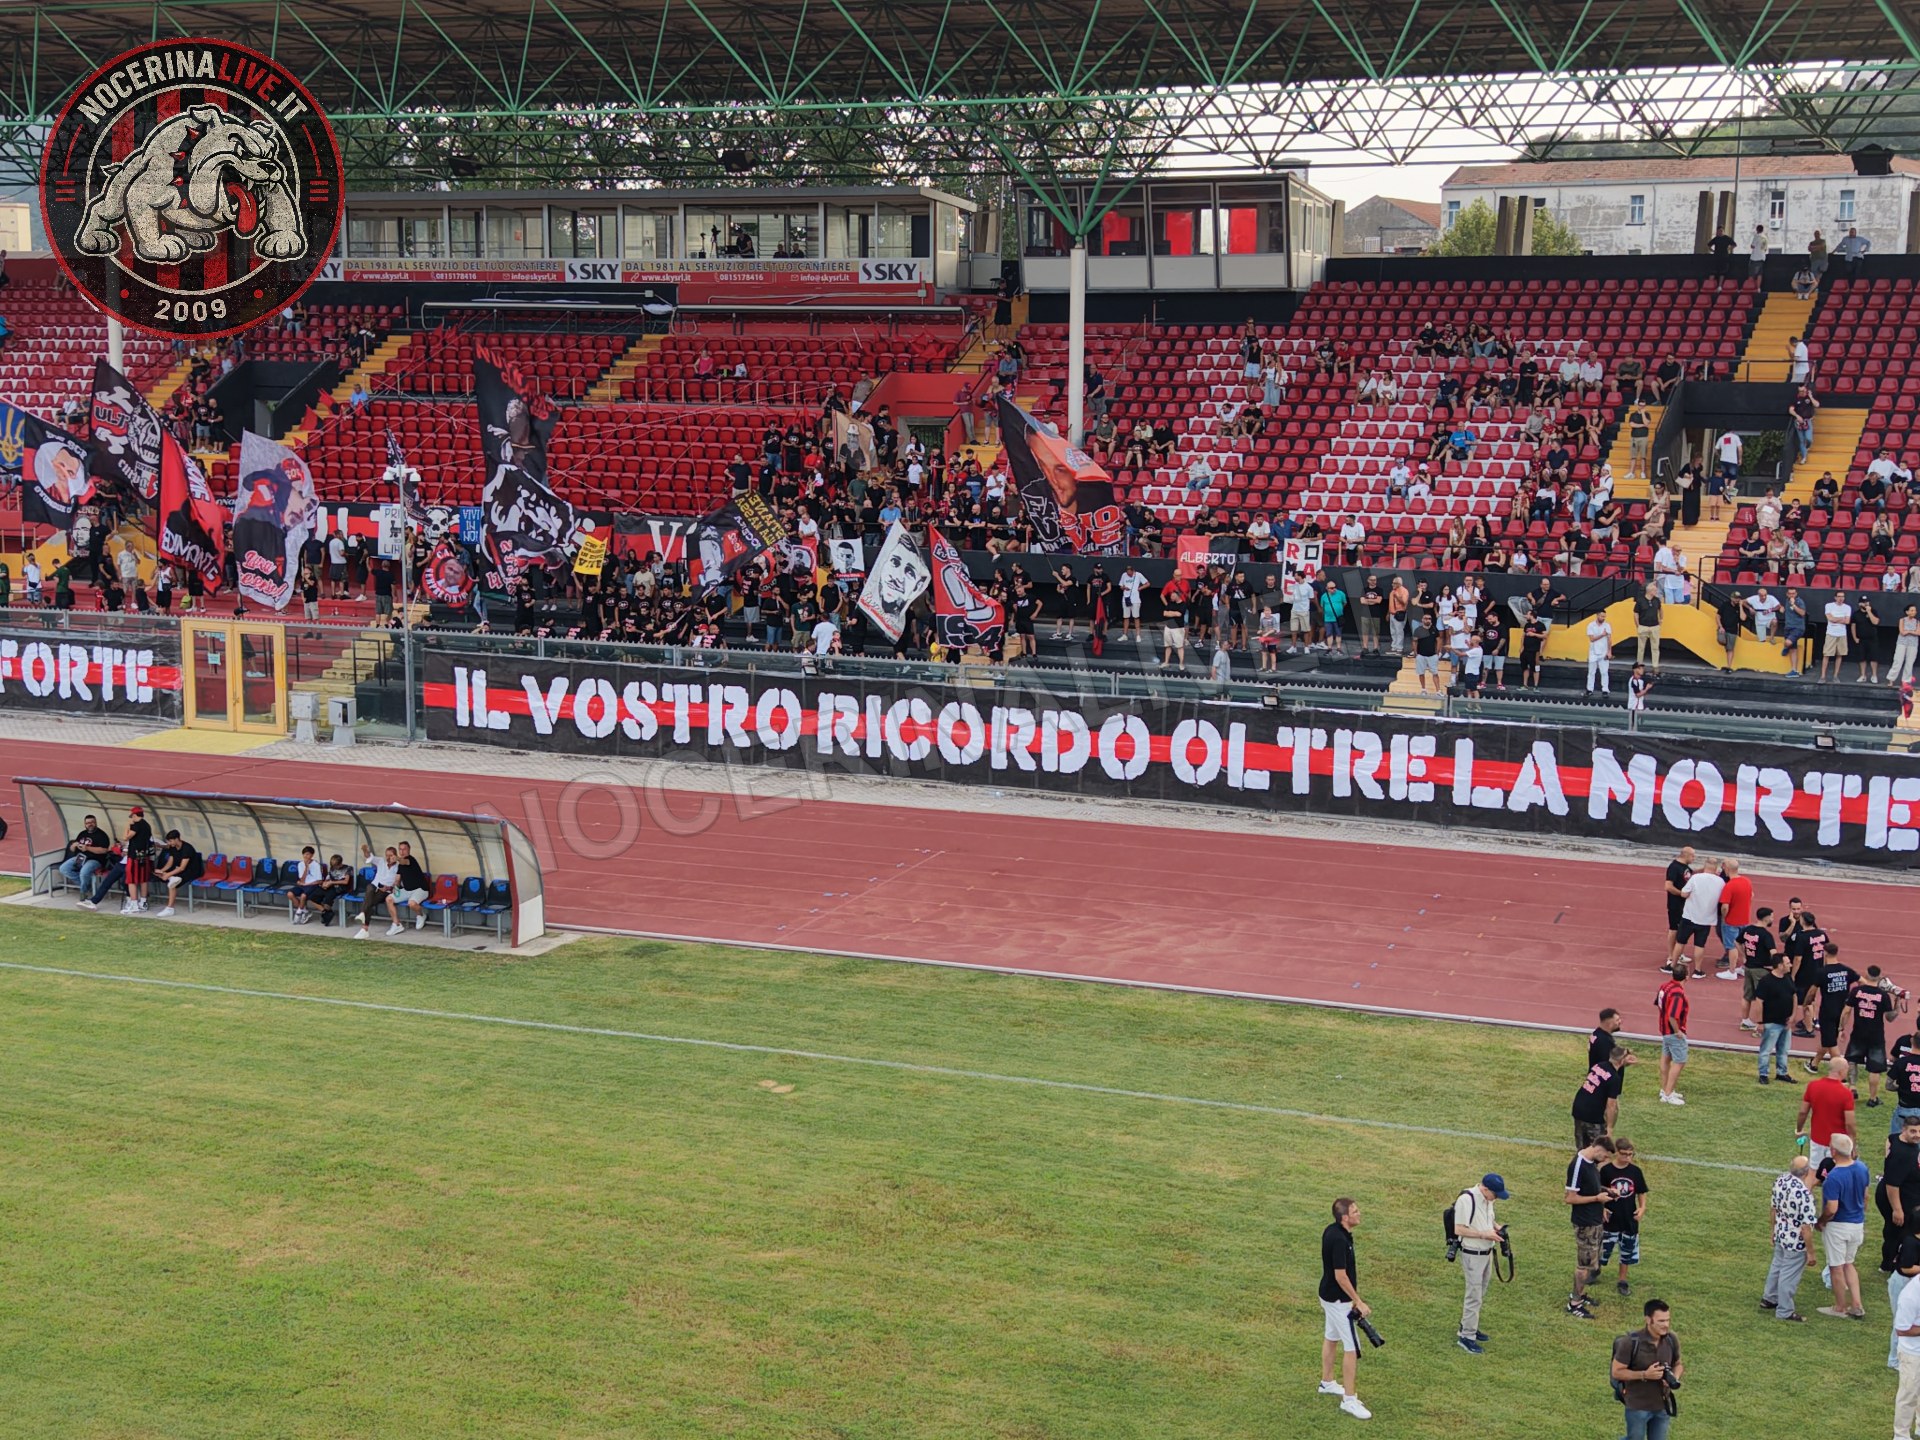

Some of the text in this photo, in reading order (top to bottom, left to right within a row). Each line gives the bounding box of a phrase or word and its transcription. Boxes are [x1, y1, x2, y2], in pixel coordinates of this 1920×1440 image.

[347, 261, 559, 270] DAL 1981 AL SERVIZIO DEL TUO CANTIERE
[625, 262, 851, 271] DAL 1981 AL SERVIZIO DEL TUO CANTIERE
[362, 272, 409, 281] www.skysrl.it
[511, 273, 557, 281] info@skysrl.it
[579, 263, 619, 280] SKY
[874, 263, 917, 281] SKY
[641, 273, 692, 282] www.skysrl.it
[800, 273, 850, 282] info@skysrl.it
[1180, 552, 1237, 566] ALBERTO
[454, 666, 510, 730] IL
[521, 675, 802, 751] VOSTRO
[816, 691, 1151, 781] RICORDO
[1453, 737, 1570, 816] LA
[1588, 747, 1920, 852] MORTE
